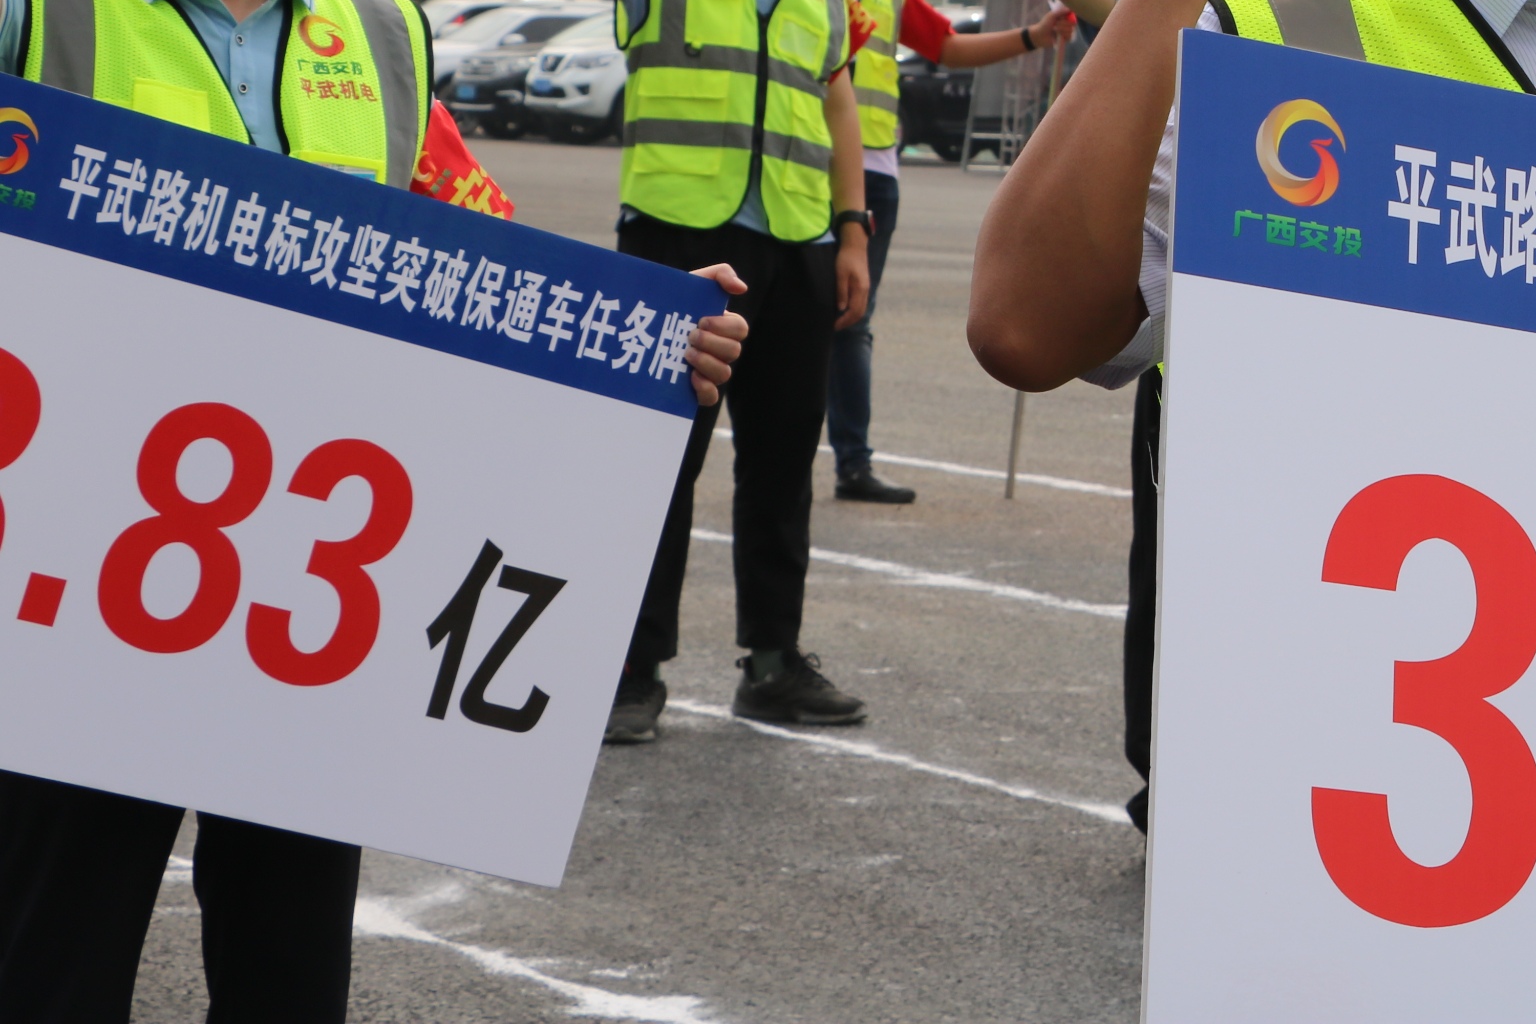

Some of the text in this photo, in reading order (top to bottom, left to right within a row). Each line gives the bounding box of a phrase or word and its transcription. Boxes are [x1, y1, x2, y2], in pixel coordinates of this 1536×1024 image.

[300, 77, 378, 103] 平武机电
[58, 143, 698, 384] 平武路机电标攻坚突破保通车任务牌
[1232, 208, 1363, 259] 广西交投
[425, 537, 569, 734] 亿
